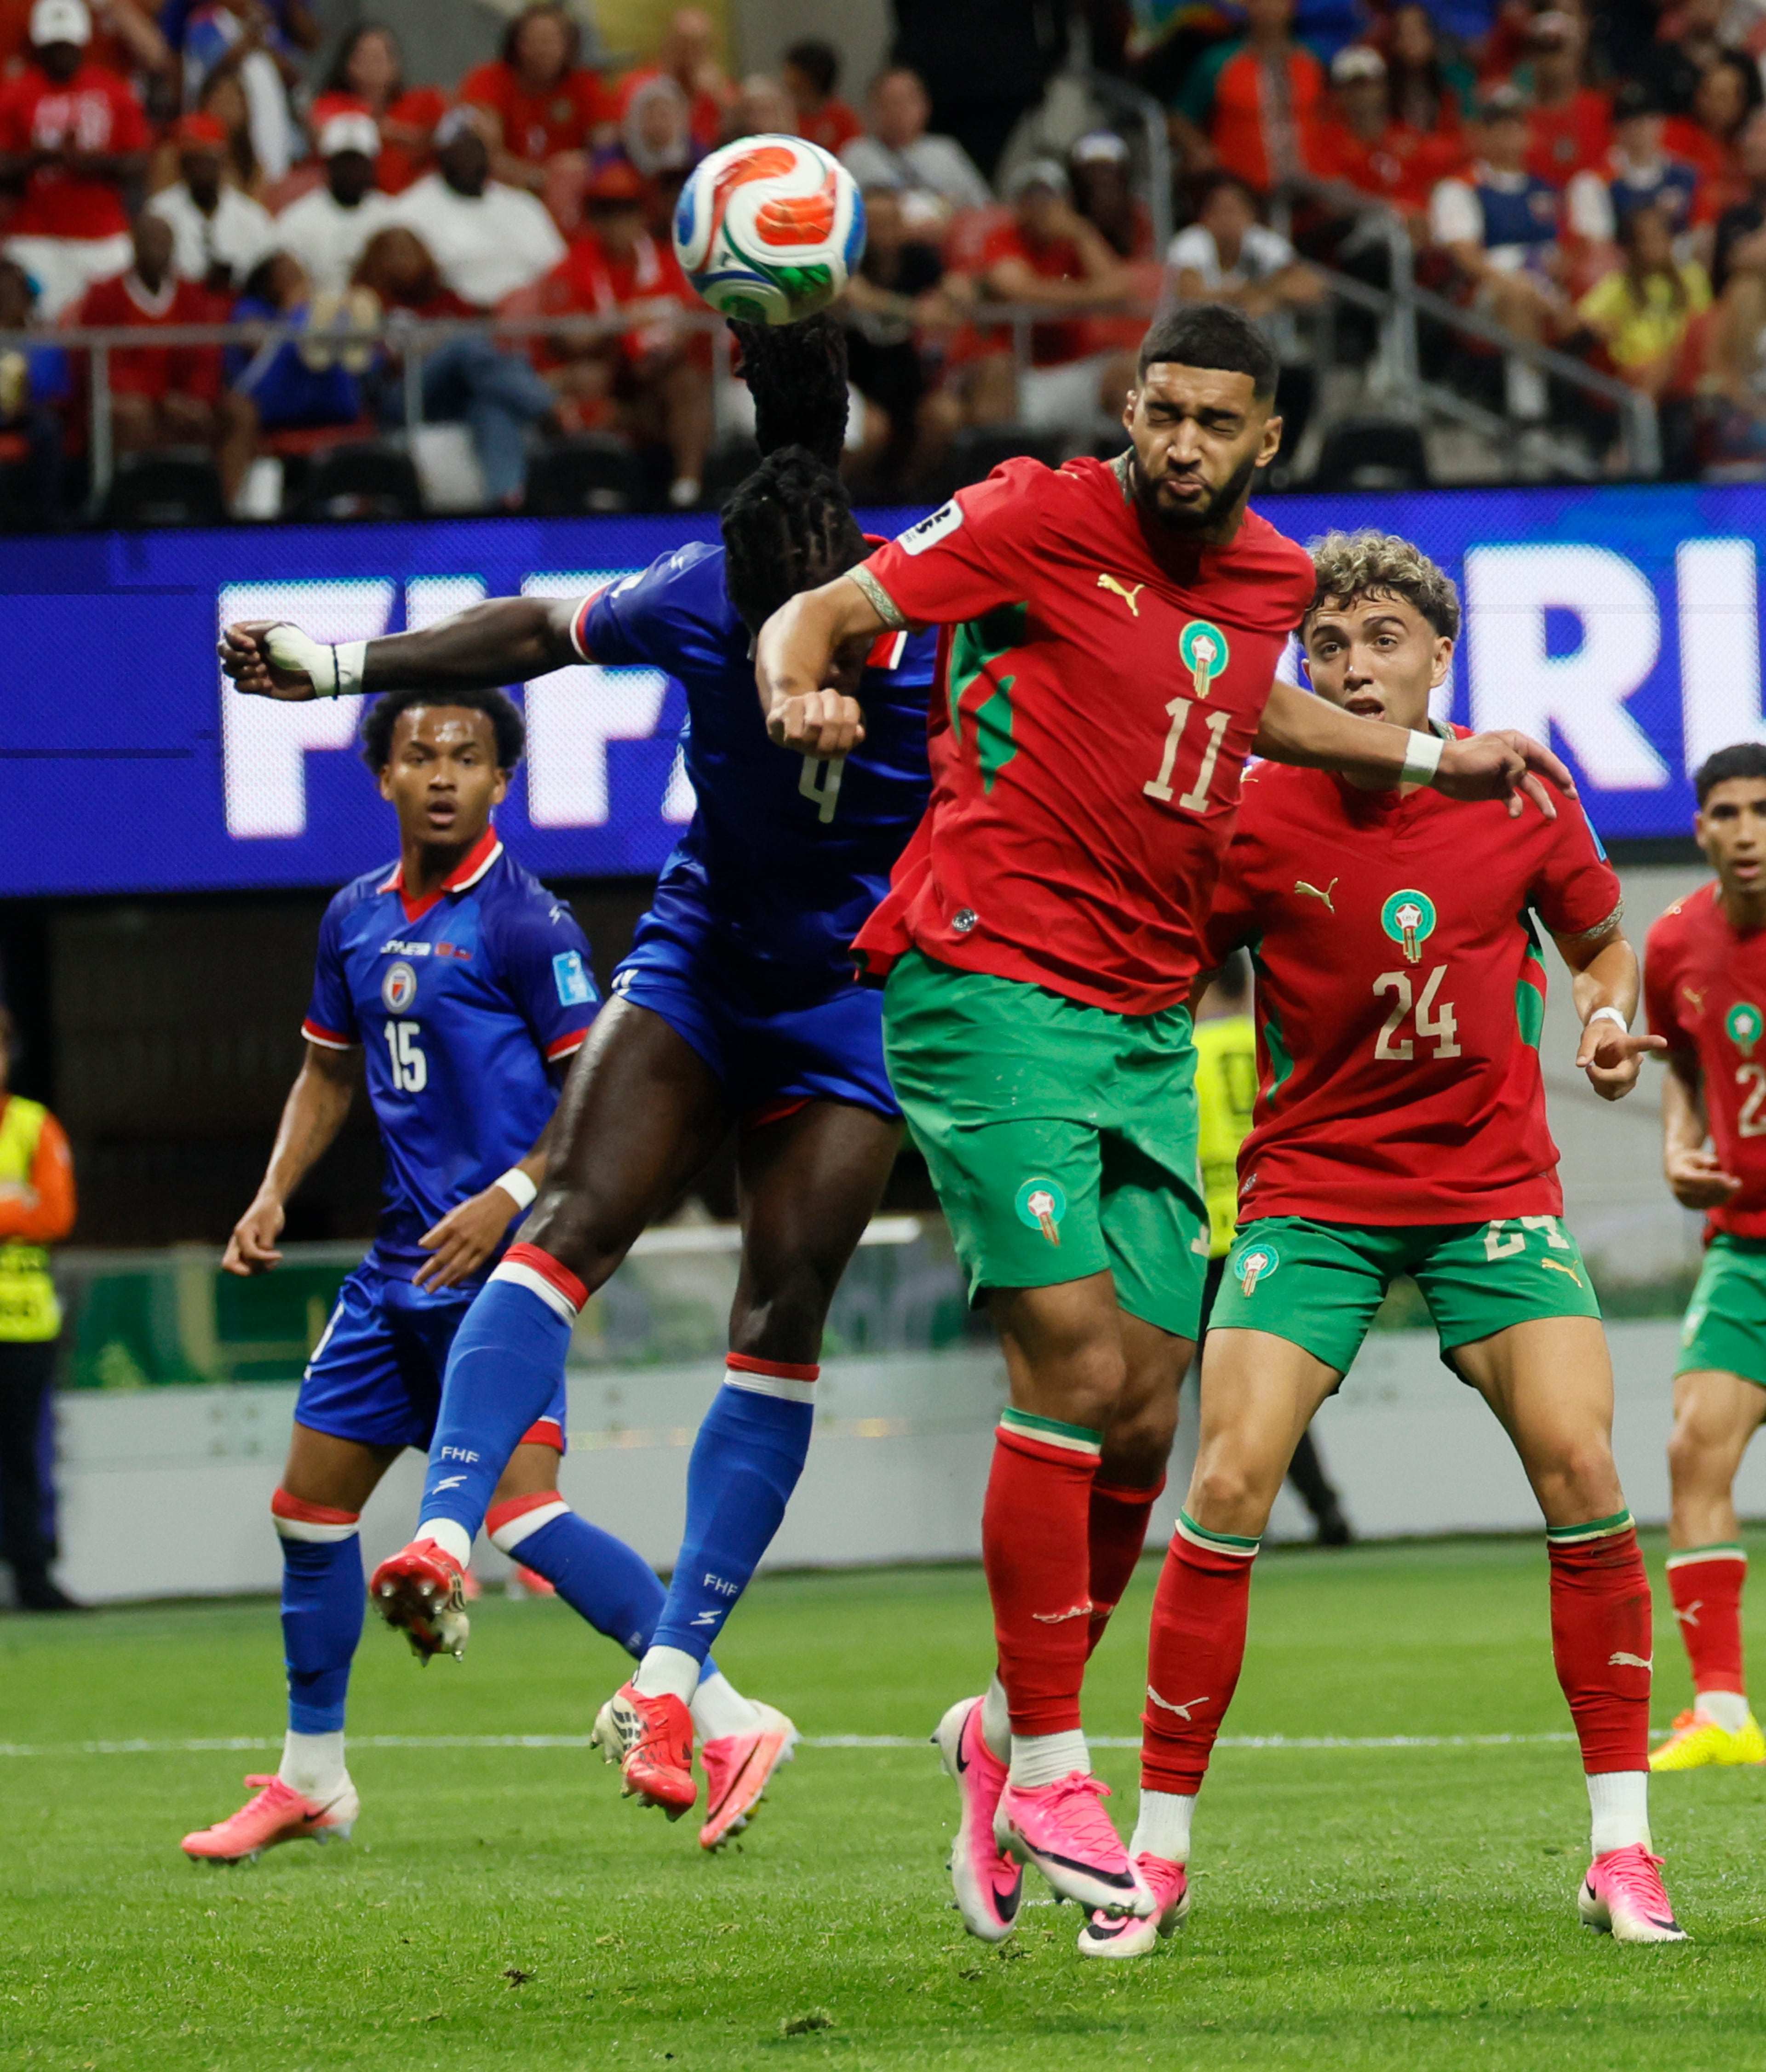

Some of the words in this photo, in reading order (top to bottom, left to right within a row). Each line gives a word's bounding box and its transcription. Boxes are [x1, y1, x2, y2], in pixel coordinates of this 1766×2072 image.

[1143, 697, 1231, 813] 11
[1372, 964, 1461, 1060] 24
[384, 1020, 427, 1093] 15
[1735, 1063, 1766, 1139] 2
[441, 1446, 480, 1463] FHF
[704, 1573, 738, 1596] FHF
